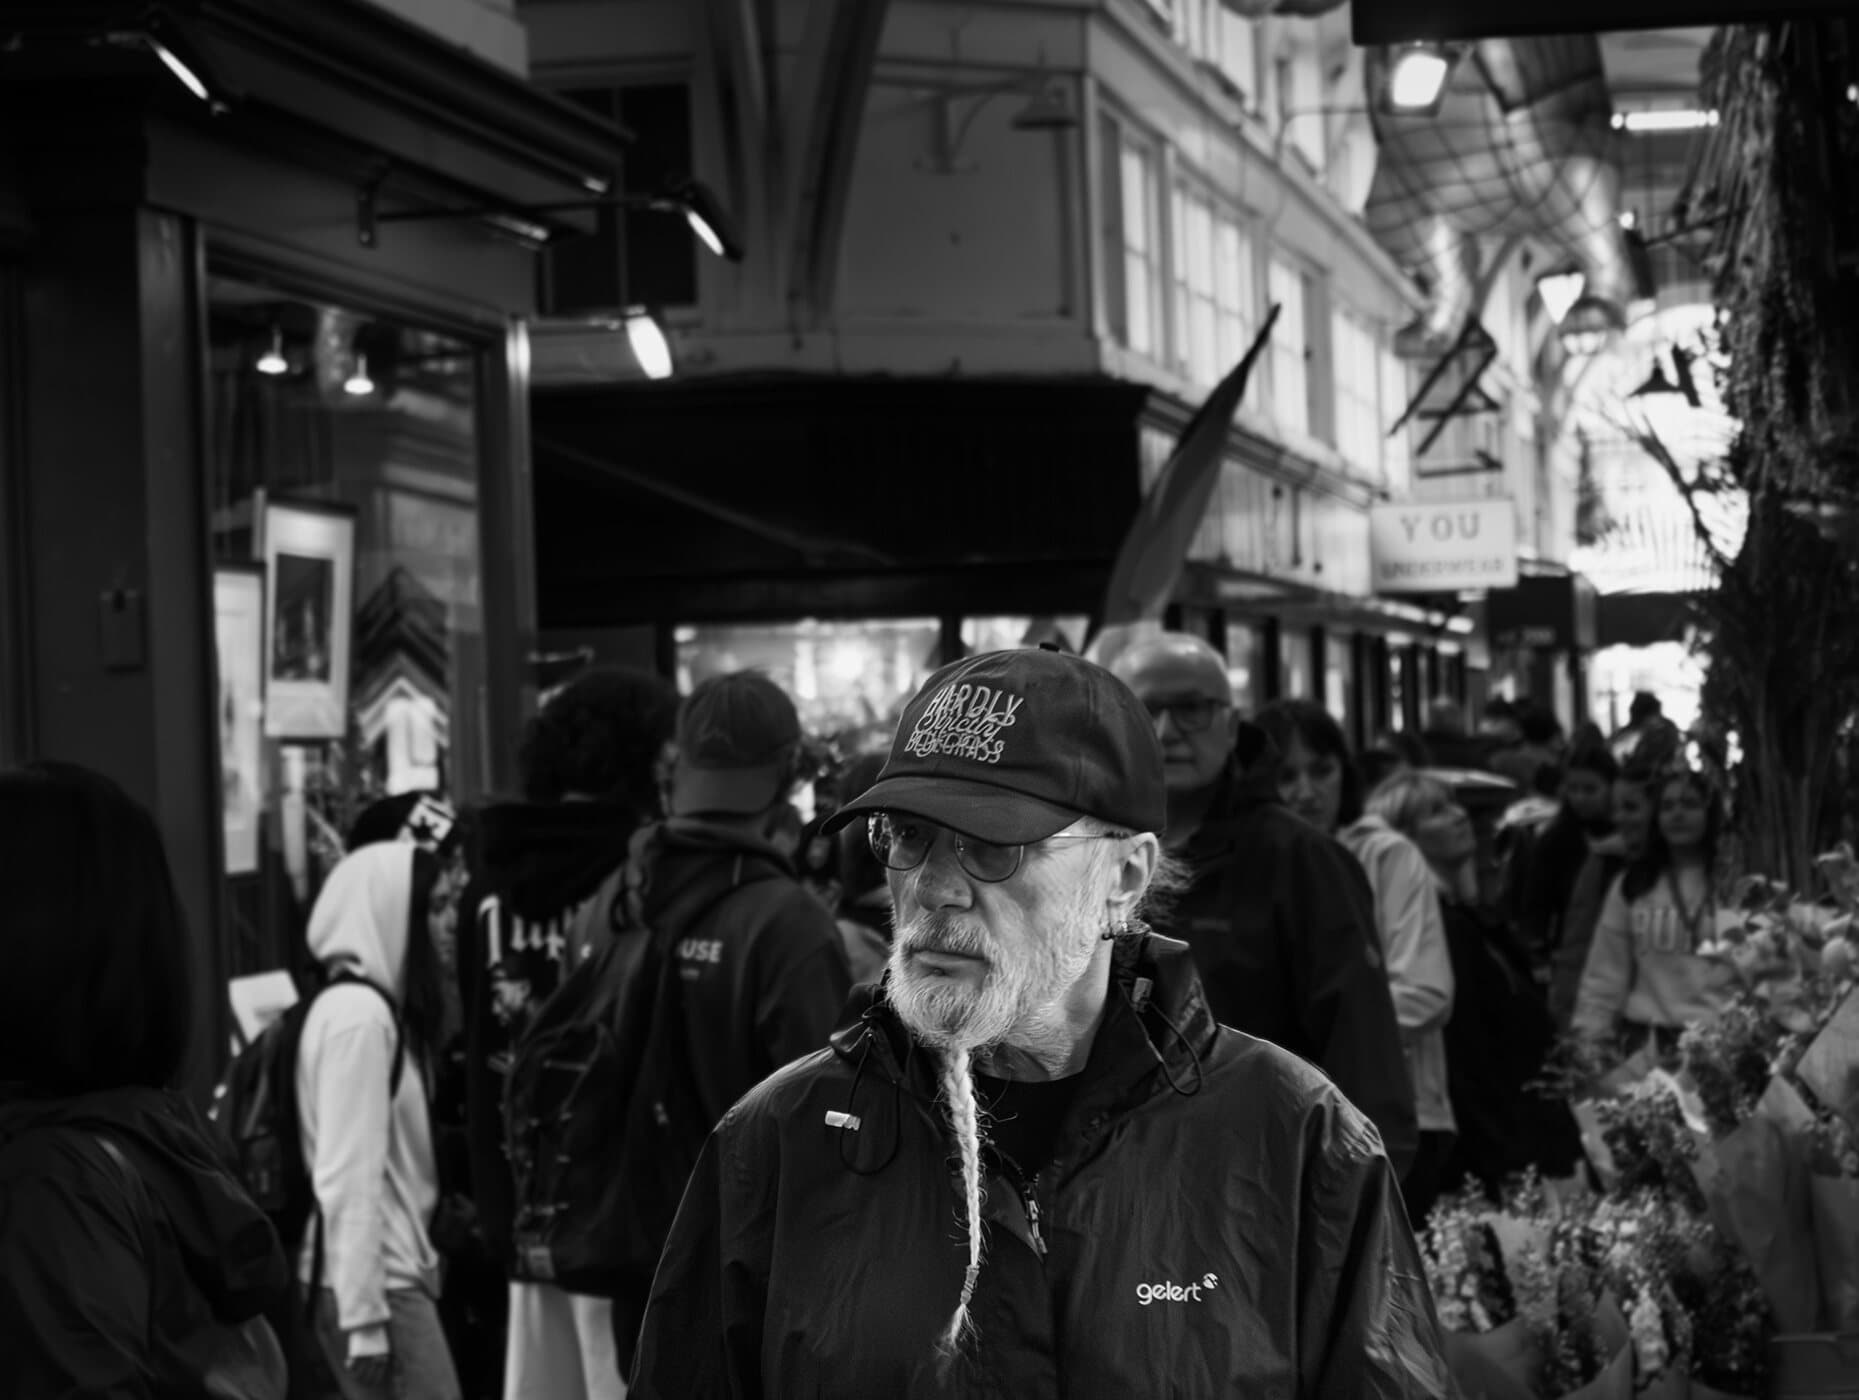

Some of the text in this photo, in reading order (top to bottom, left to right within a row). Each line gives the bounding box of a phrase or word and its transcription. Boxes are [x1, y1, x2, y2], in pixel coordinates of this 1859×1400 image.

[1399, 511, 1481, 544] YOU
[923, 683, 1025, 722] HARDLY
[675, 937, 724, 963] USE
[1135, 1280, 1203, 1306] gelert
